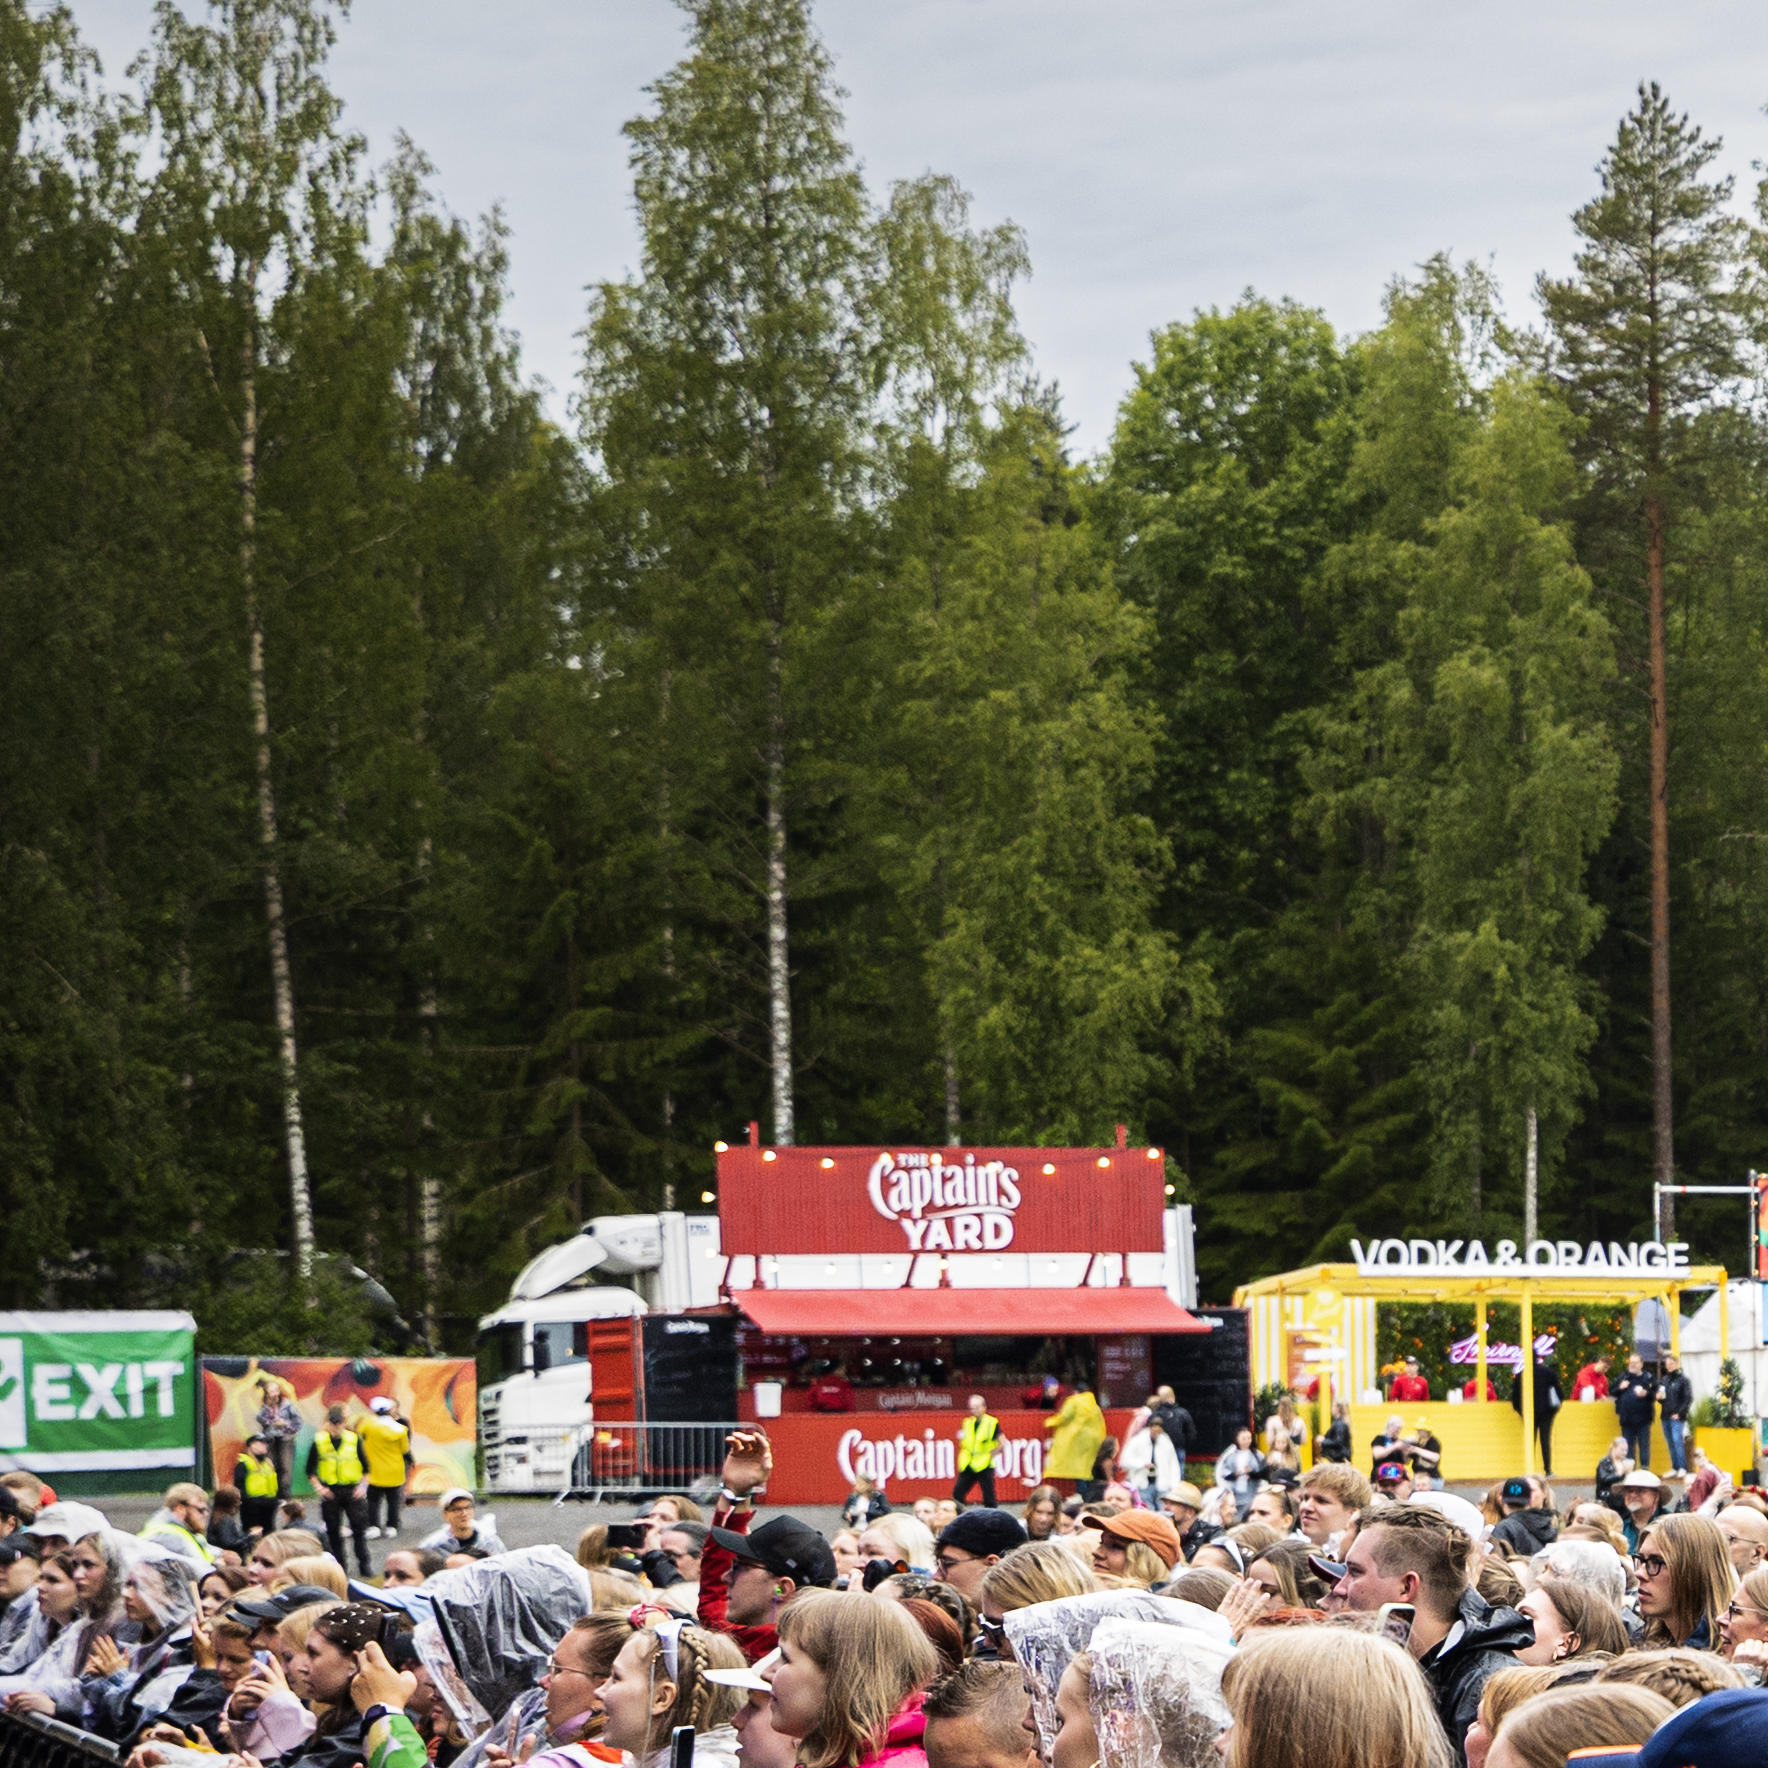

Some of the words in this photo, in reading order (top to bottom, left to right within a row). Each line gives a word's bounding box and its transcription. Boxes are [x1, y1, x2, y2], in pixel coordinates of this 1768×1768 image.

[897, 1153, 929, 1167] THE
[868, 1153, 1021, 1221] Captain's
[900, 1214, 1015, 1251] YARD
[1349, 1238, 1489, 1267] VODKA
[1495, 1239, 1523, 1267] &
[1525, 1239, 1690, 1270] ORANGE
[31, 1360, 185, 1421] EXIT
[837, 1428, 955, 1490] Captain
